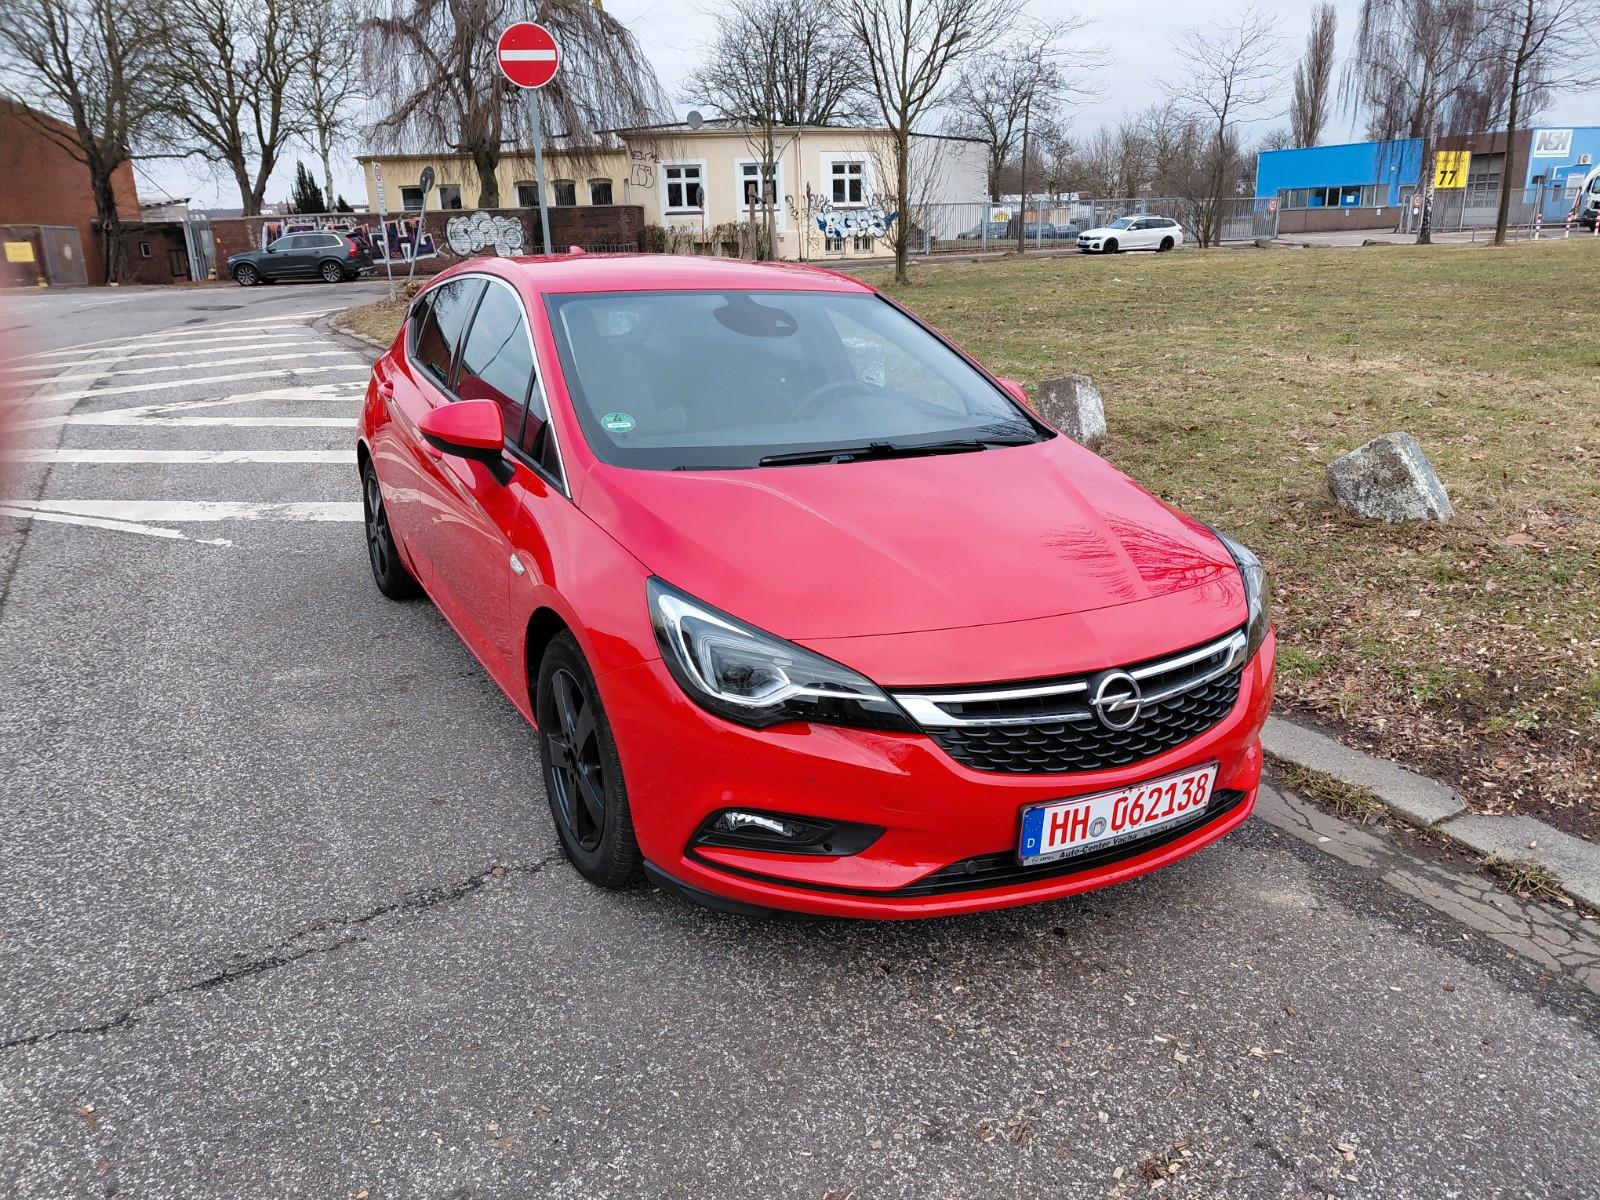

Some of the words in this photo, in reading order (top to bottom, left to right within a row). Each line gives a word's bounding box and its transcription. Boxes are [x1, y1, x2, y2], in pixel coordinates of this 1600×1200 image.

[1537, 131, 1570, 151] NSH
[1438, 170, 1457, 186] 77
[1049, 805, 1091, 847] HH
[1111, 773, 1209, 831] 062138
[1026, 837, 1035, 849] D
[1059, 840, 1111, 859] Auto-Center
[1113, 833, 1138, 845] Vacha
